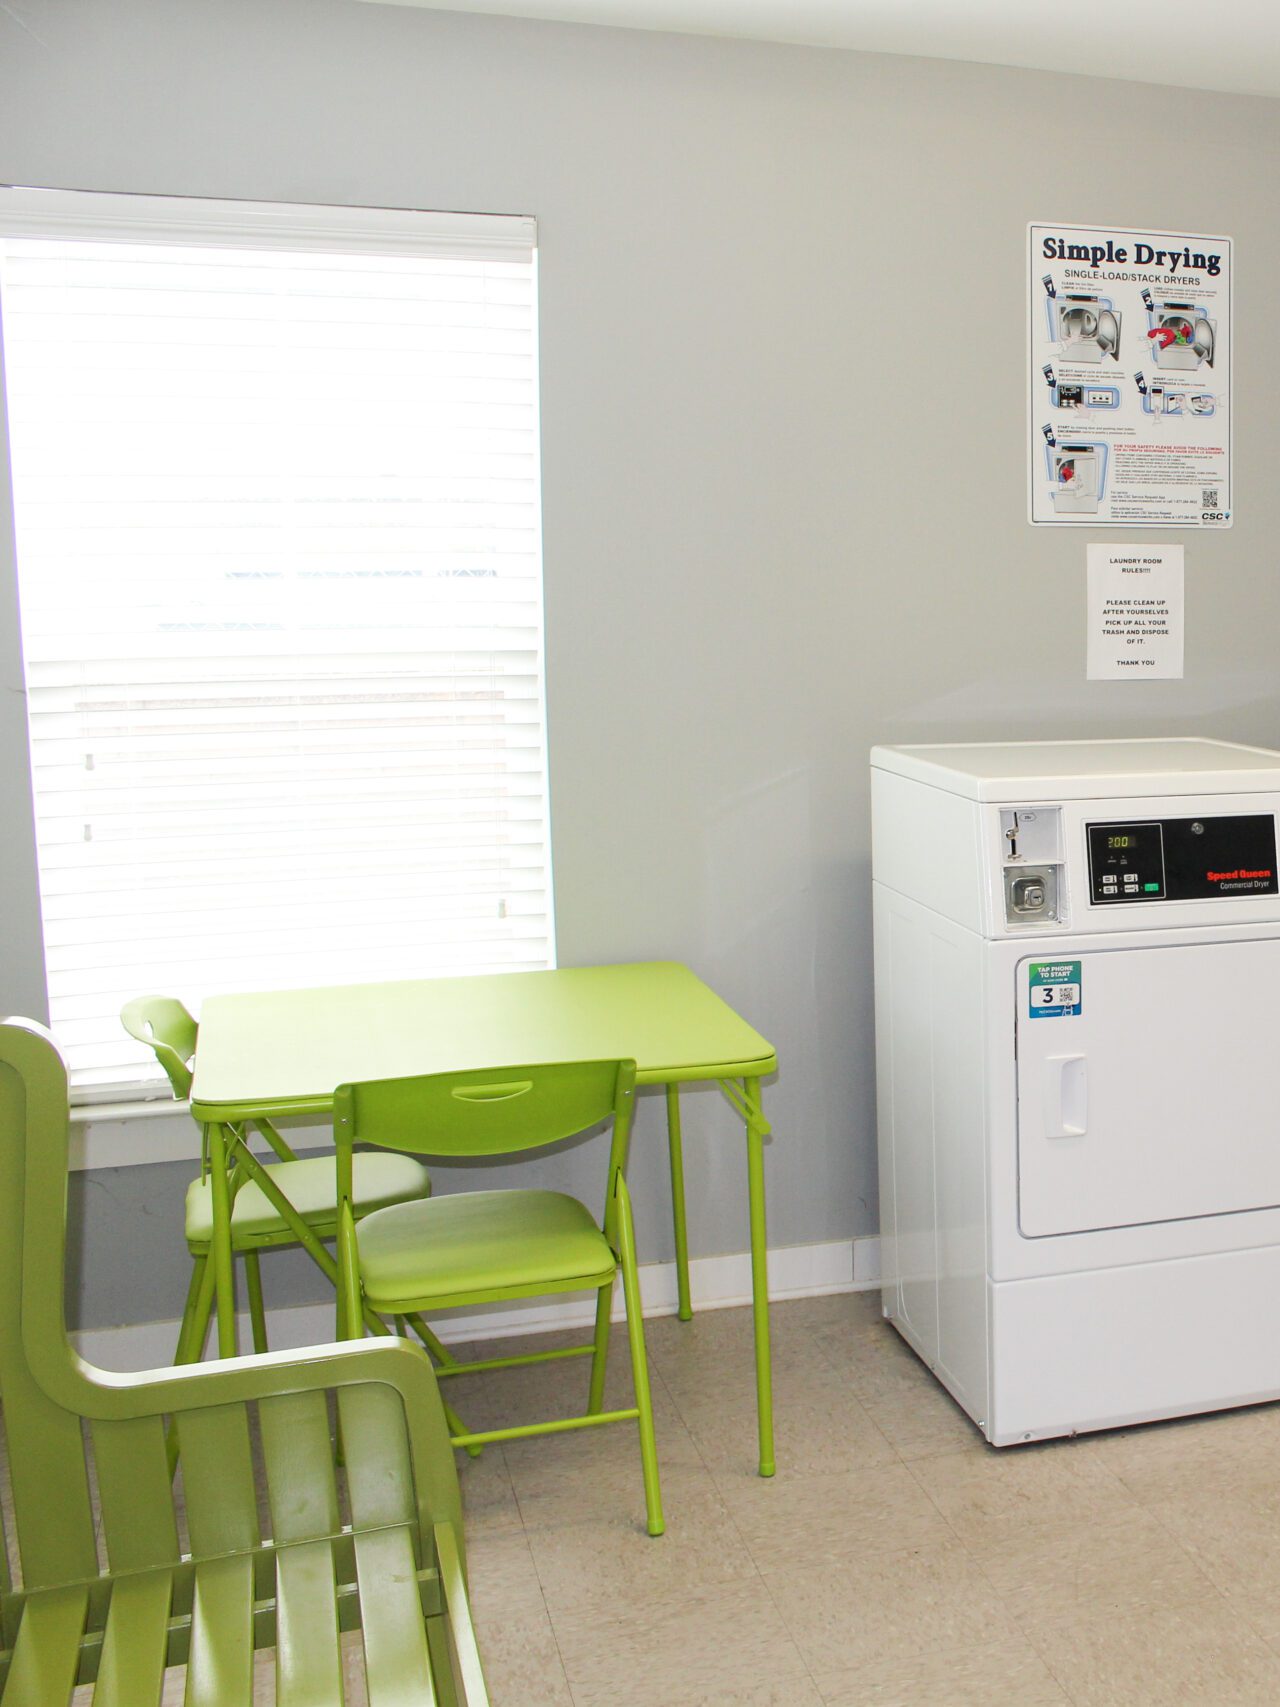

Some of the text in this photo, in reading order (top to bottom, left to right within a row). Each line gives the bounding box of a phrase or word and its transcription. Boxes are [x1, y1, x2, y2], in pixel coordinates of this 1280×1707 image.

[1043, 237, 1221, 276] Simple Drying
[1064, 270, 1201, 286] SINGLE-LOAD/STACK DRYERS
[1047, 373, 1053, 381] 3
[1207, 869, 1271, 882] Speed Queen
[1220, 882, 1253, 890] Commercial
[1043, 988, 1053, 1003] 3
